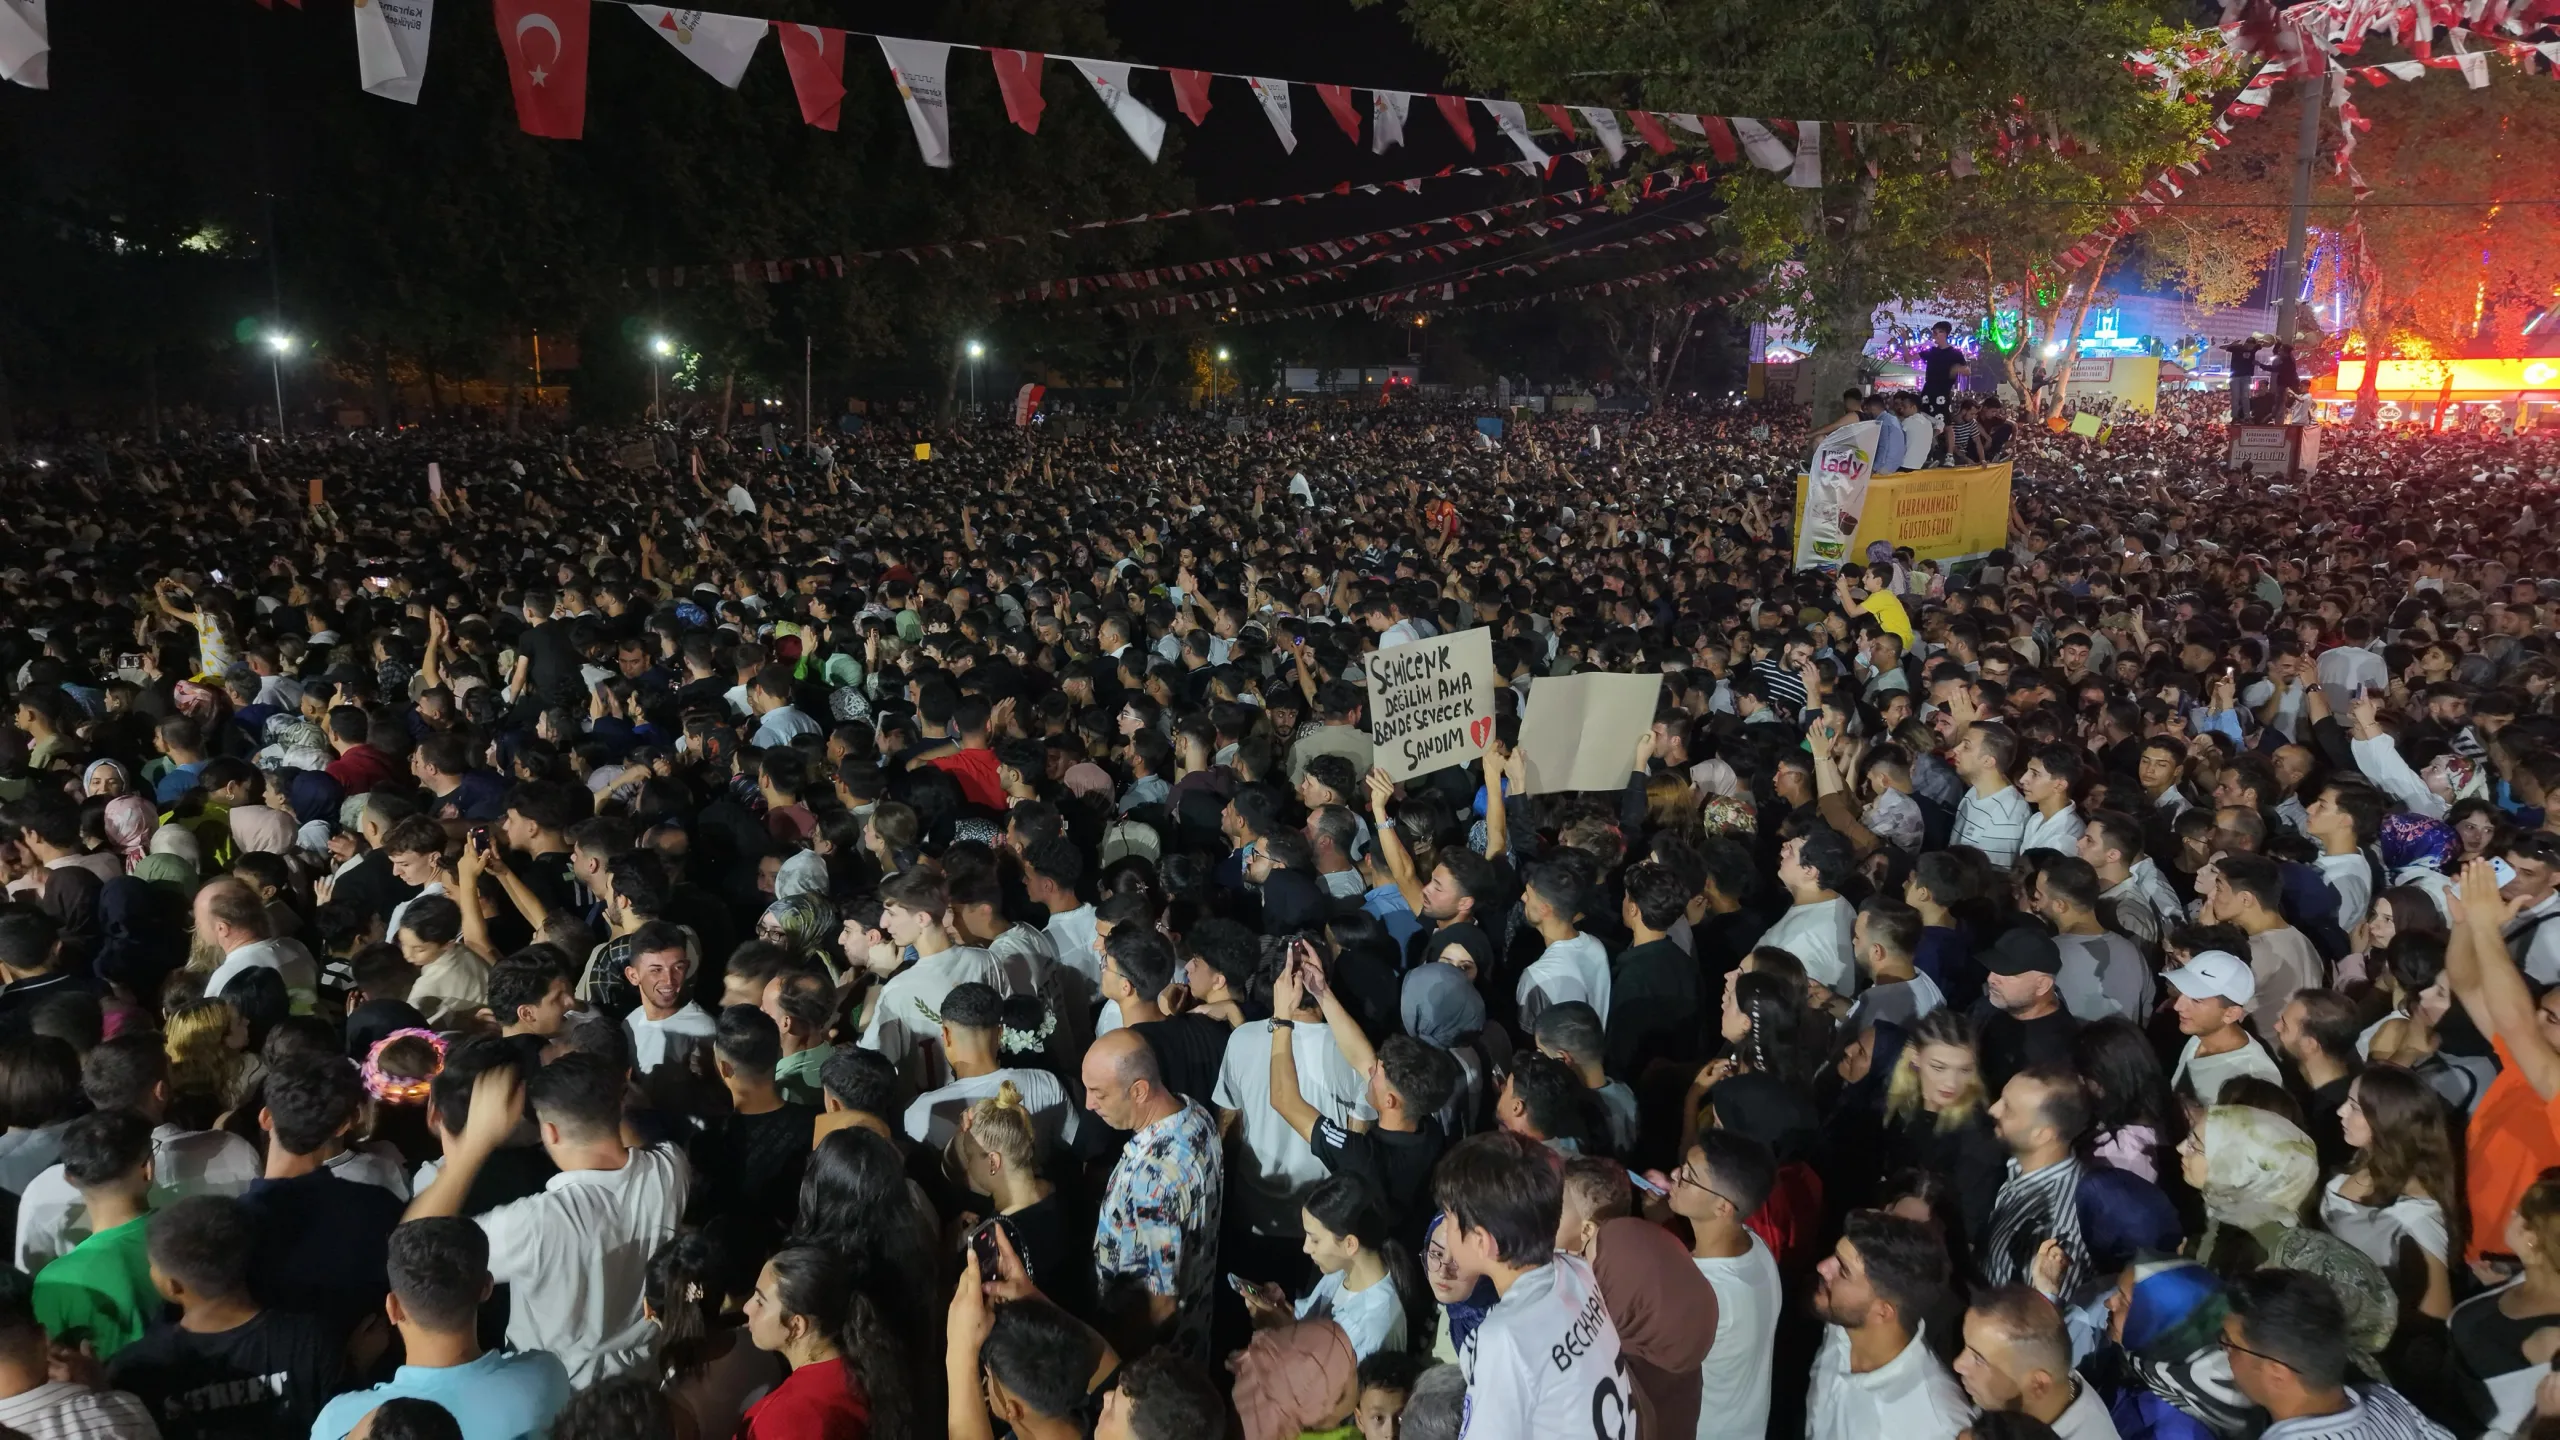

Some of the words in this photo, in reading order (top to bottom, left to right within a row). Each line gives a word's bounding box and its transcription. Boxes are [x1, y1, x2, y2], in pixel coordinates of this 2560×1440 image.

[1820, 450, 1864, 480] lady
[1828, 449, 1848, 459] miss
[1898, 519, 1931, 540] AĞUSTOS
[1932, 517, 1953, 536] FUARI
[1385, 684, 1432, 717] DEĞİLİM
[1438, 672, 1473, 700] AMA
[1403, 727, 1464, 771] SANDIM
